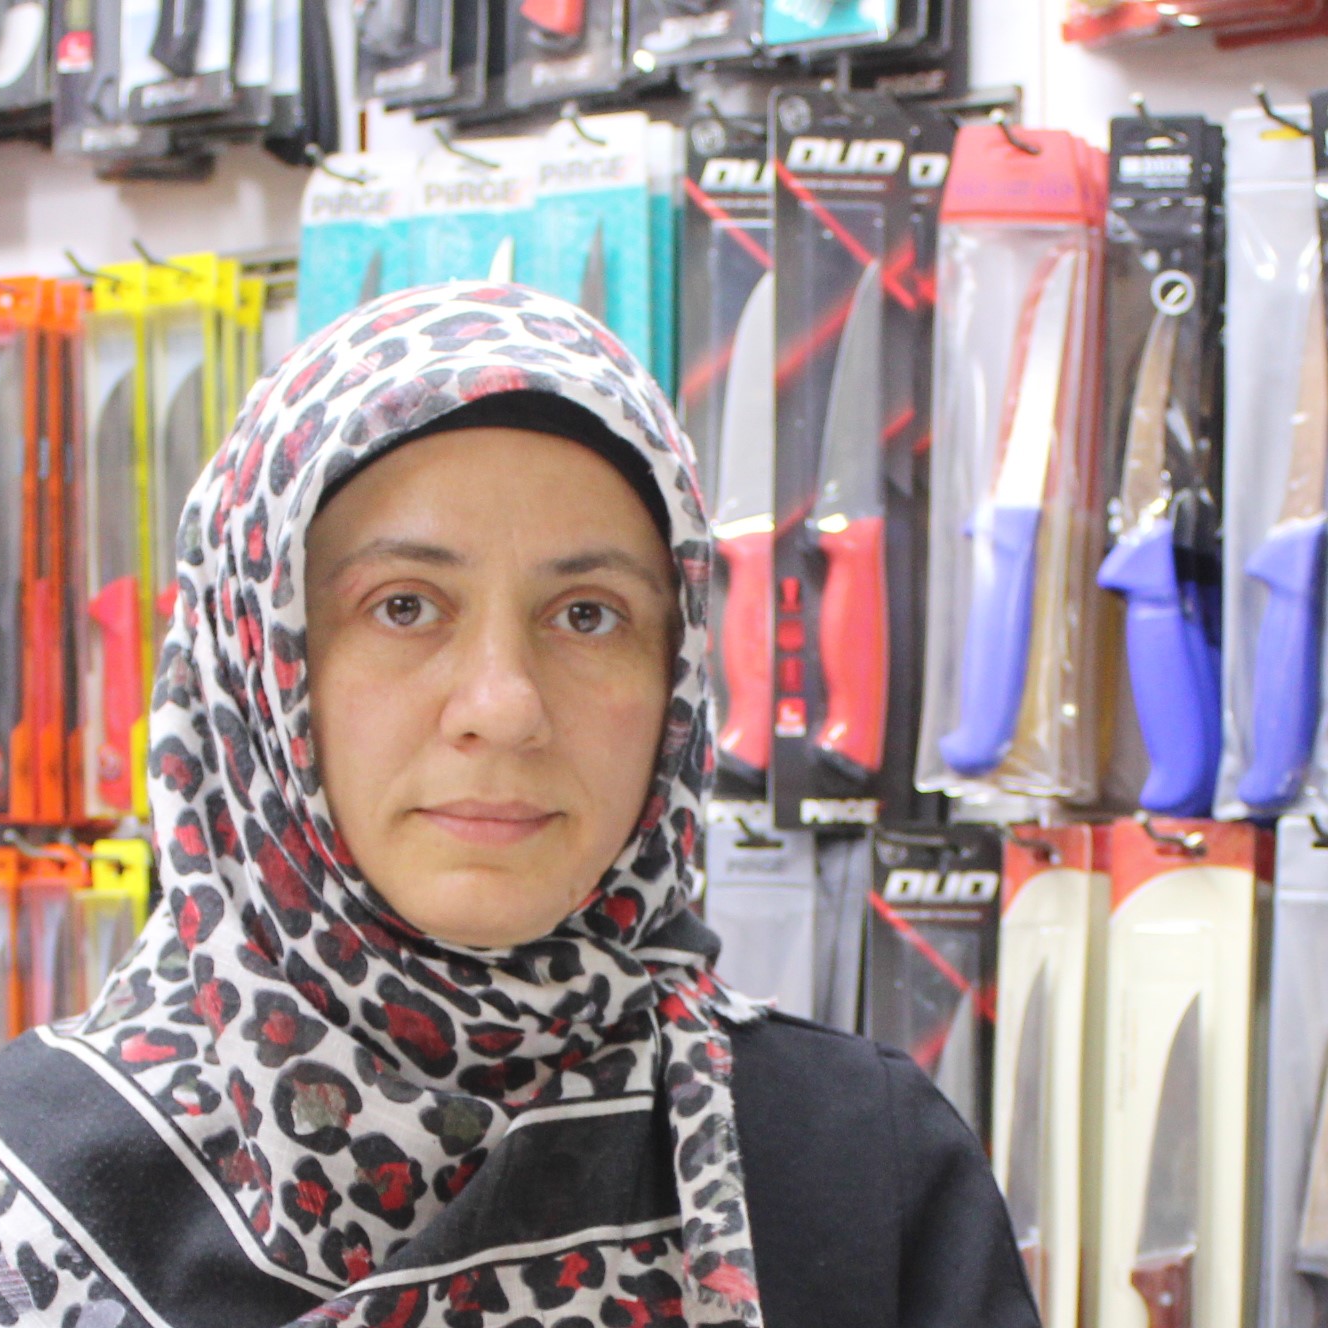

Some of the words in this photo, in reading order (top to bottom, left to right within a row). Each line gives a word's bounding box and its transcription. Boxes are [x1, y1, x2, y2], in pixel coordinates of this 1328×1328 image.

[785, 139, 904, 173] DUO
[700, 159, 773, 193] DU
[883, 870, 999, 902] DUO
